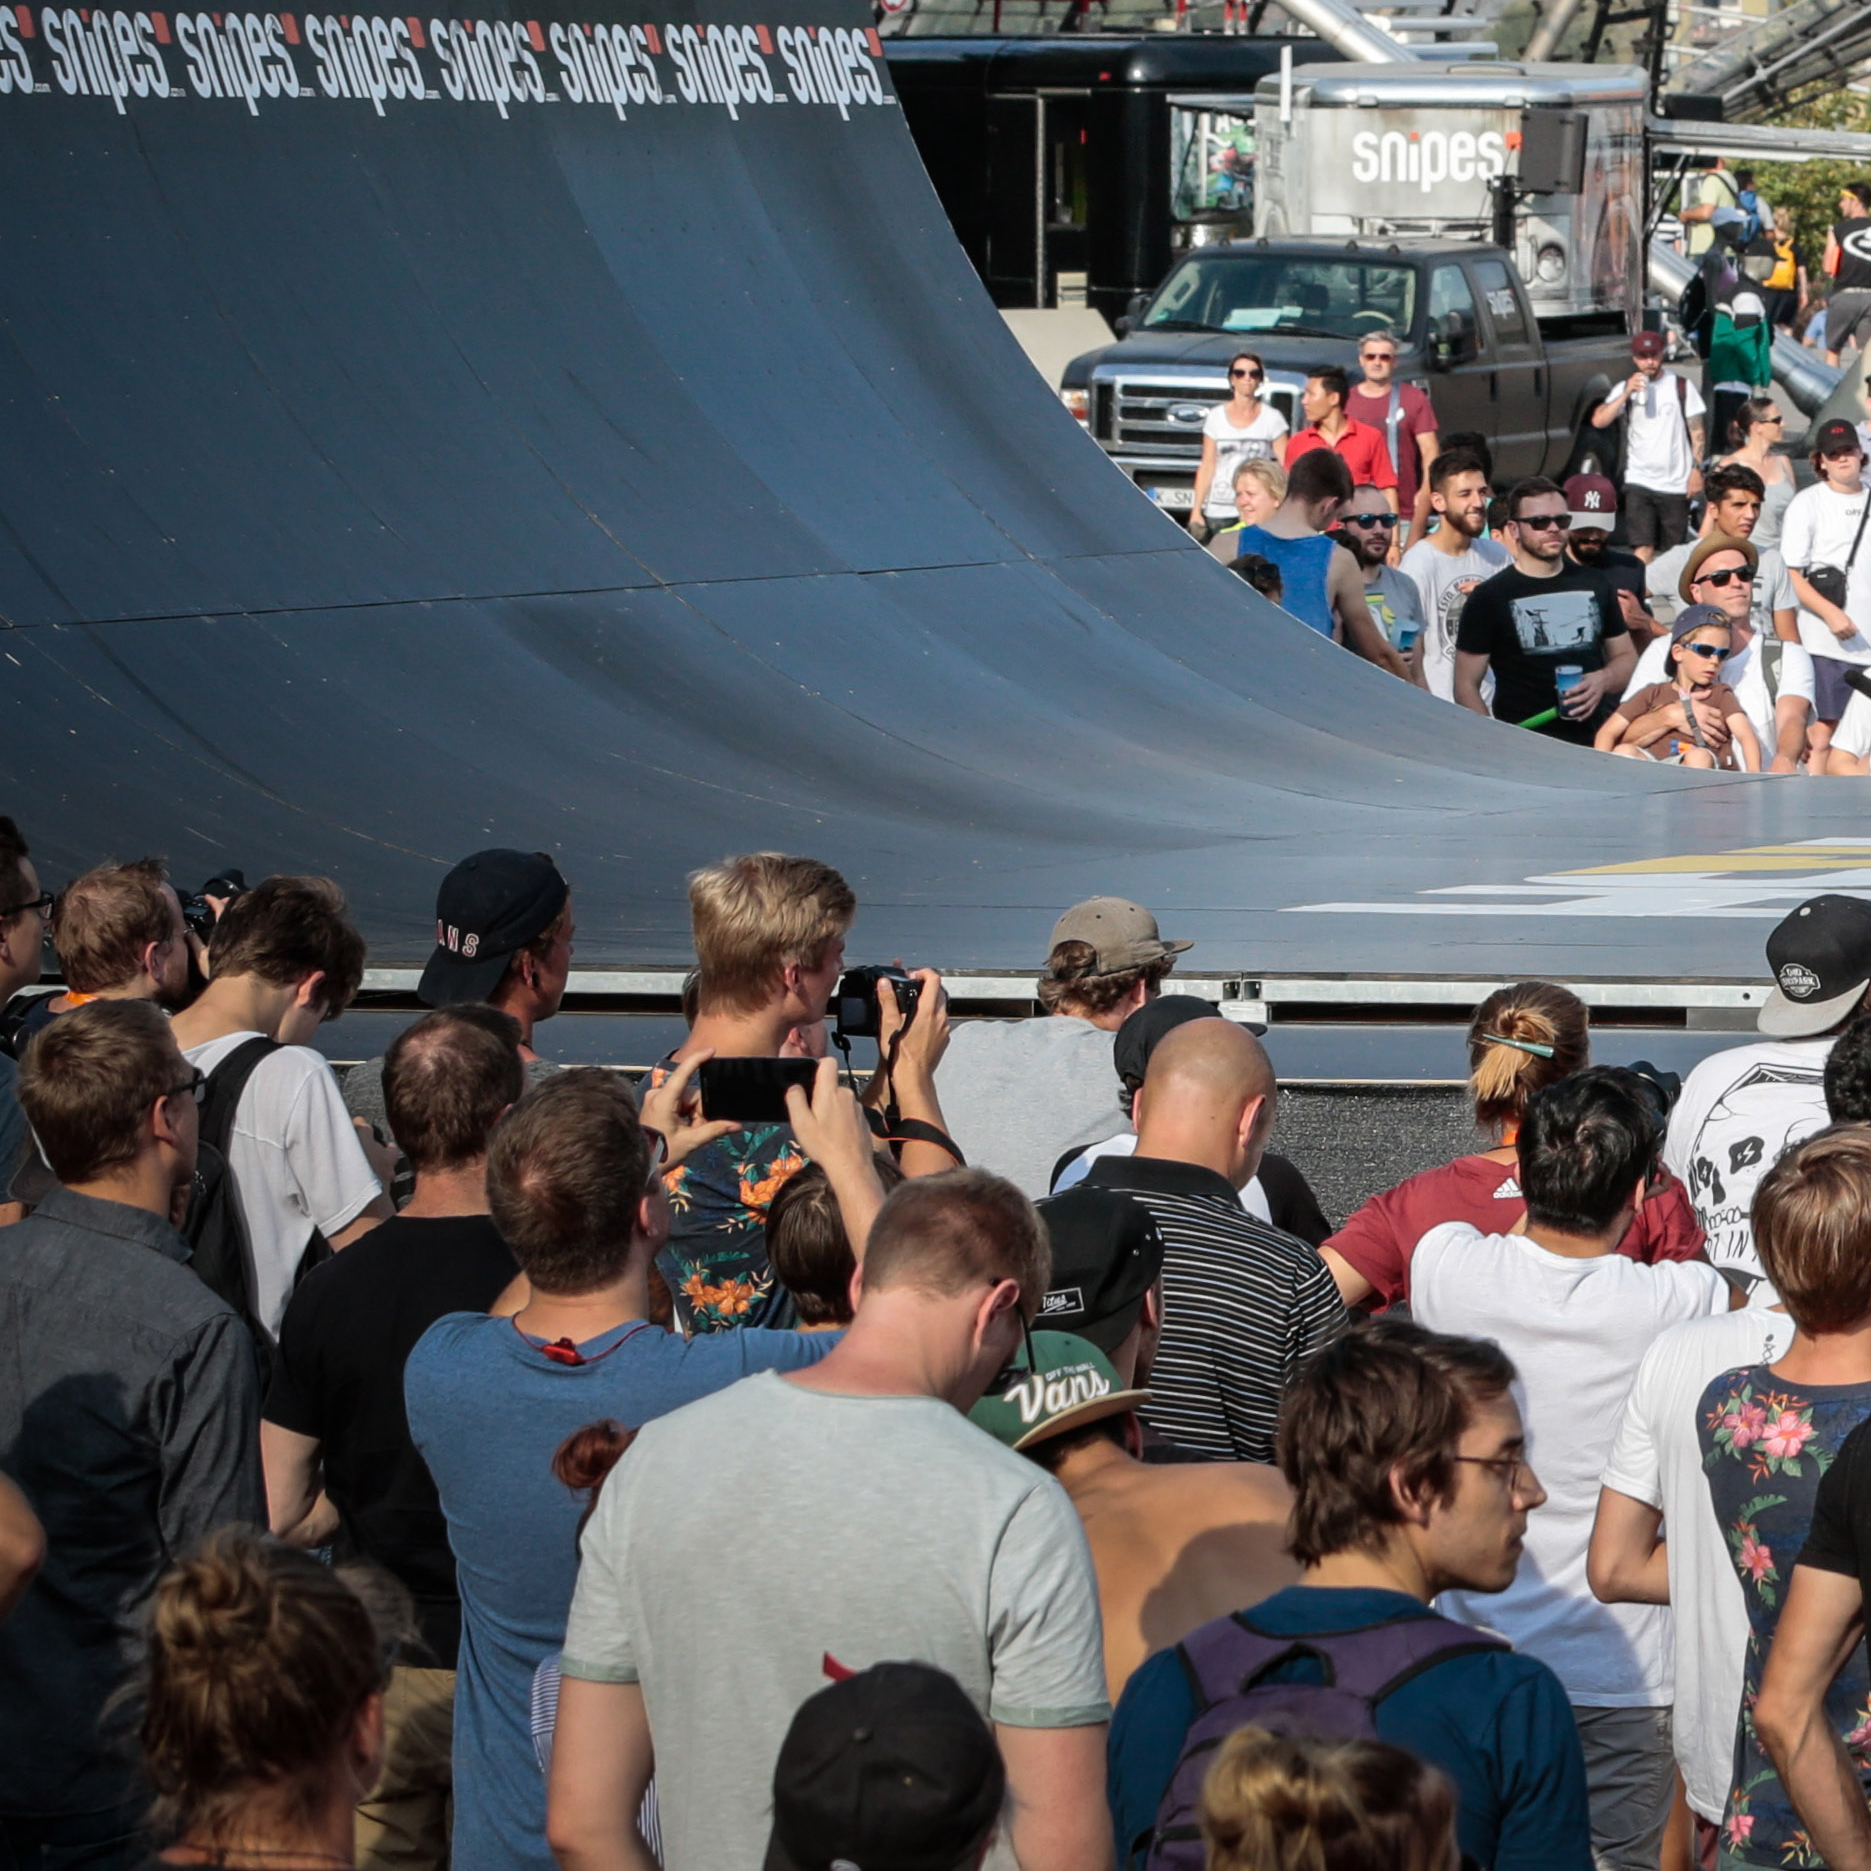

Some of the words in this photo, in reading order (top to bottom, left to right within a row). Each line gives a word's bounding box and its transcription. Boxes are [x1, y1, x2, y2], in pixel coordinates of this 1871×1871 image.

[41, 7, 171, 116] snipes
[176, 12, 300, 117] snipes
[305, 13, 425, 118] snipes
[430, 19, 545, 120] snipes
[550, 22, 663, 121] snipes
[665, 23, 774, 121] snipes
[777, 25, 883, 122] snipes
[1353, 131, 1504, 192] snipes
[1003, 1369, 1110, 1423] Vans
